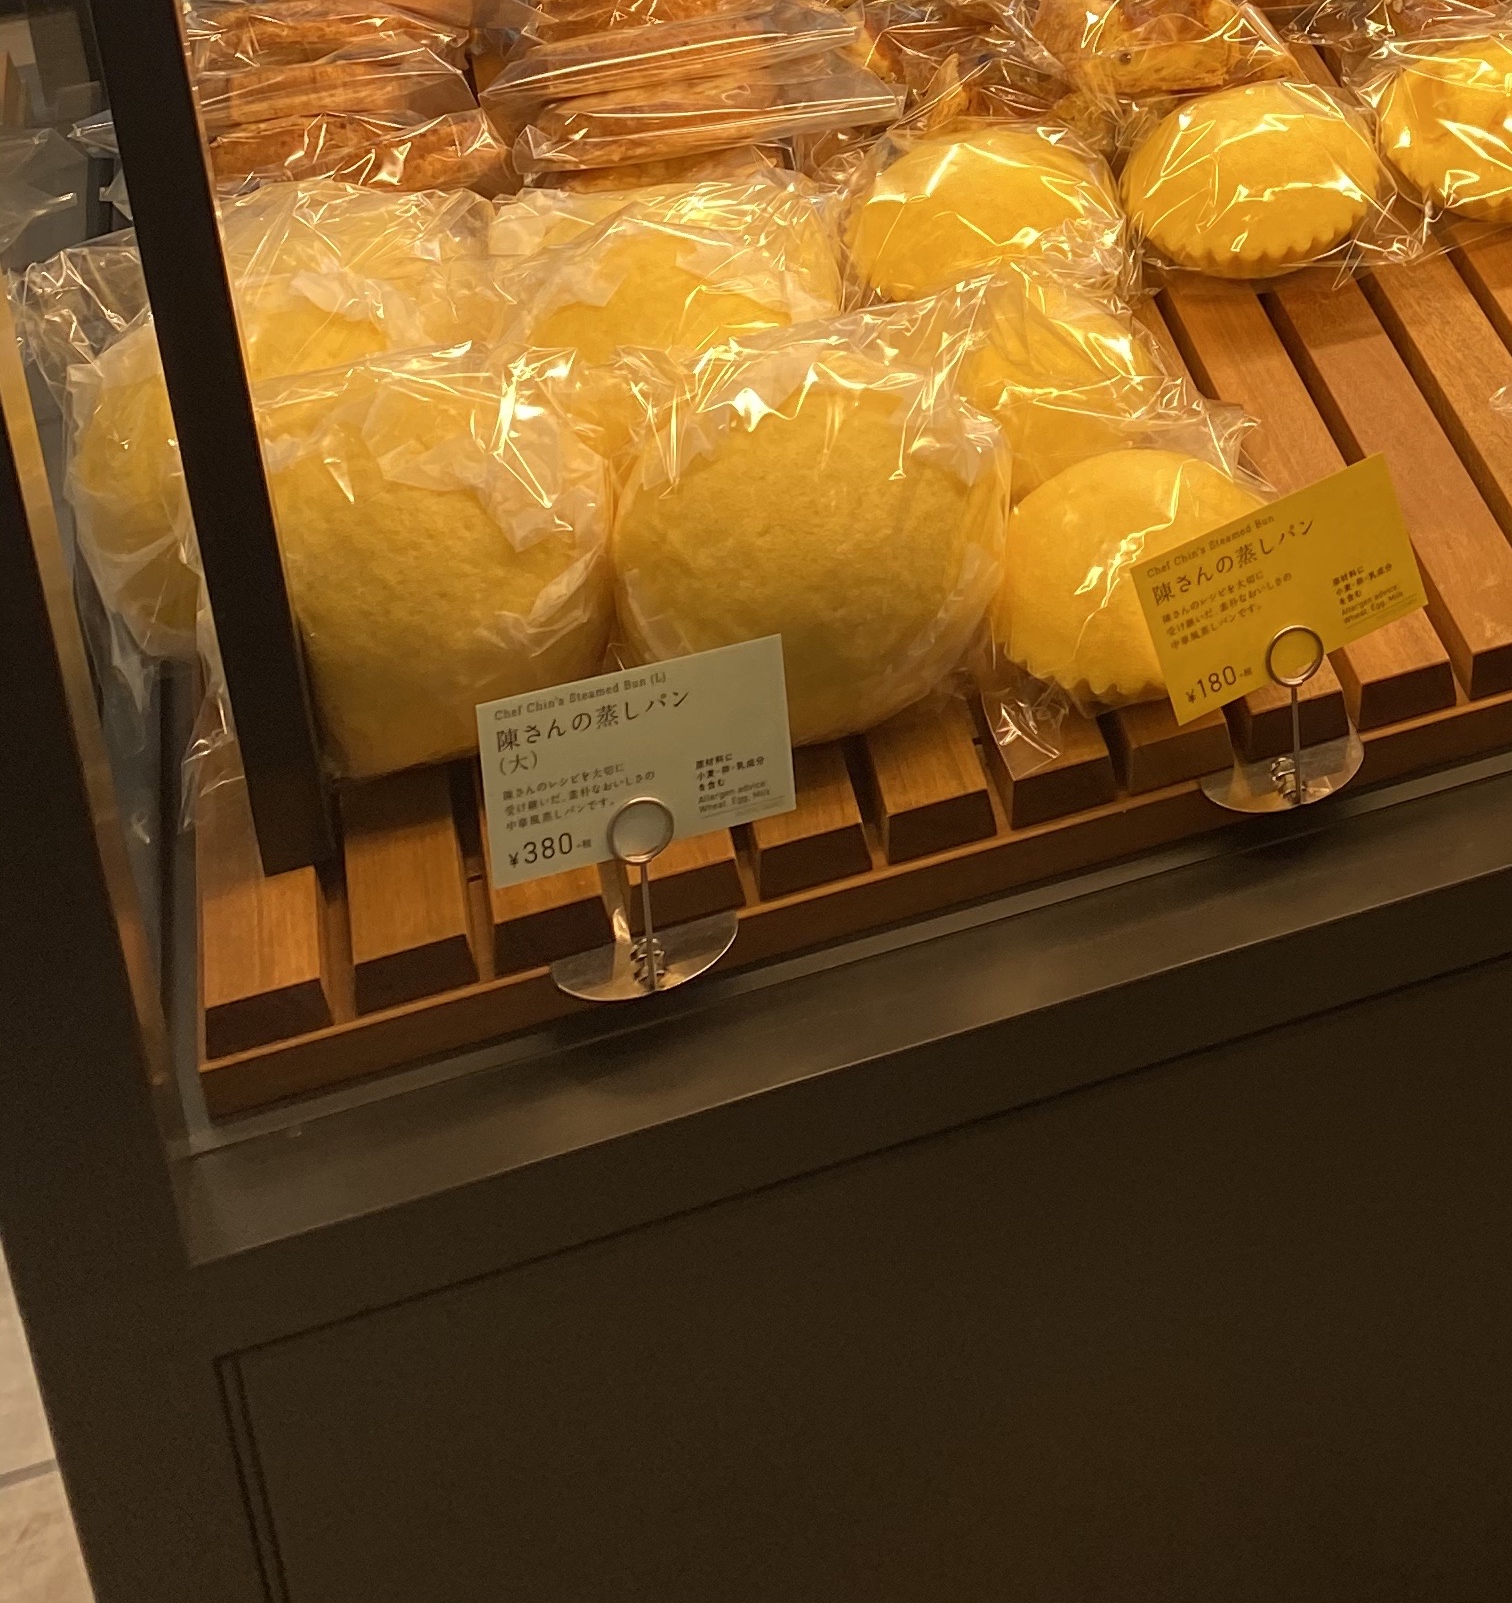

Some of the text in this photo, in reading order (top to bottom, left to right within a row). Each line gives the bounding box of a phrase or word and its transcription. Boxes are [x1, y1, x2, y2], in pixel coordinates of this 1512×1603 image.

[1145, 560, 1171, 579] Chef
[1253, 514, 1275, 529] Bun
[1150, 518, 1314, 607] 陳さんの蒸しパン
[493, 704, 523, 721] Chef
[623, 677, 646, 691] Bun
[649, 670, 667, 685] (L)
[1184, 664, 1237, 704] ¥180
[495, 690, 689, 754] 陳さんの蒸しパン
[498, 749, 539, 777] （大）
[507, 831, 573, 867] ¥380
